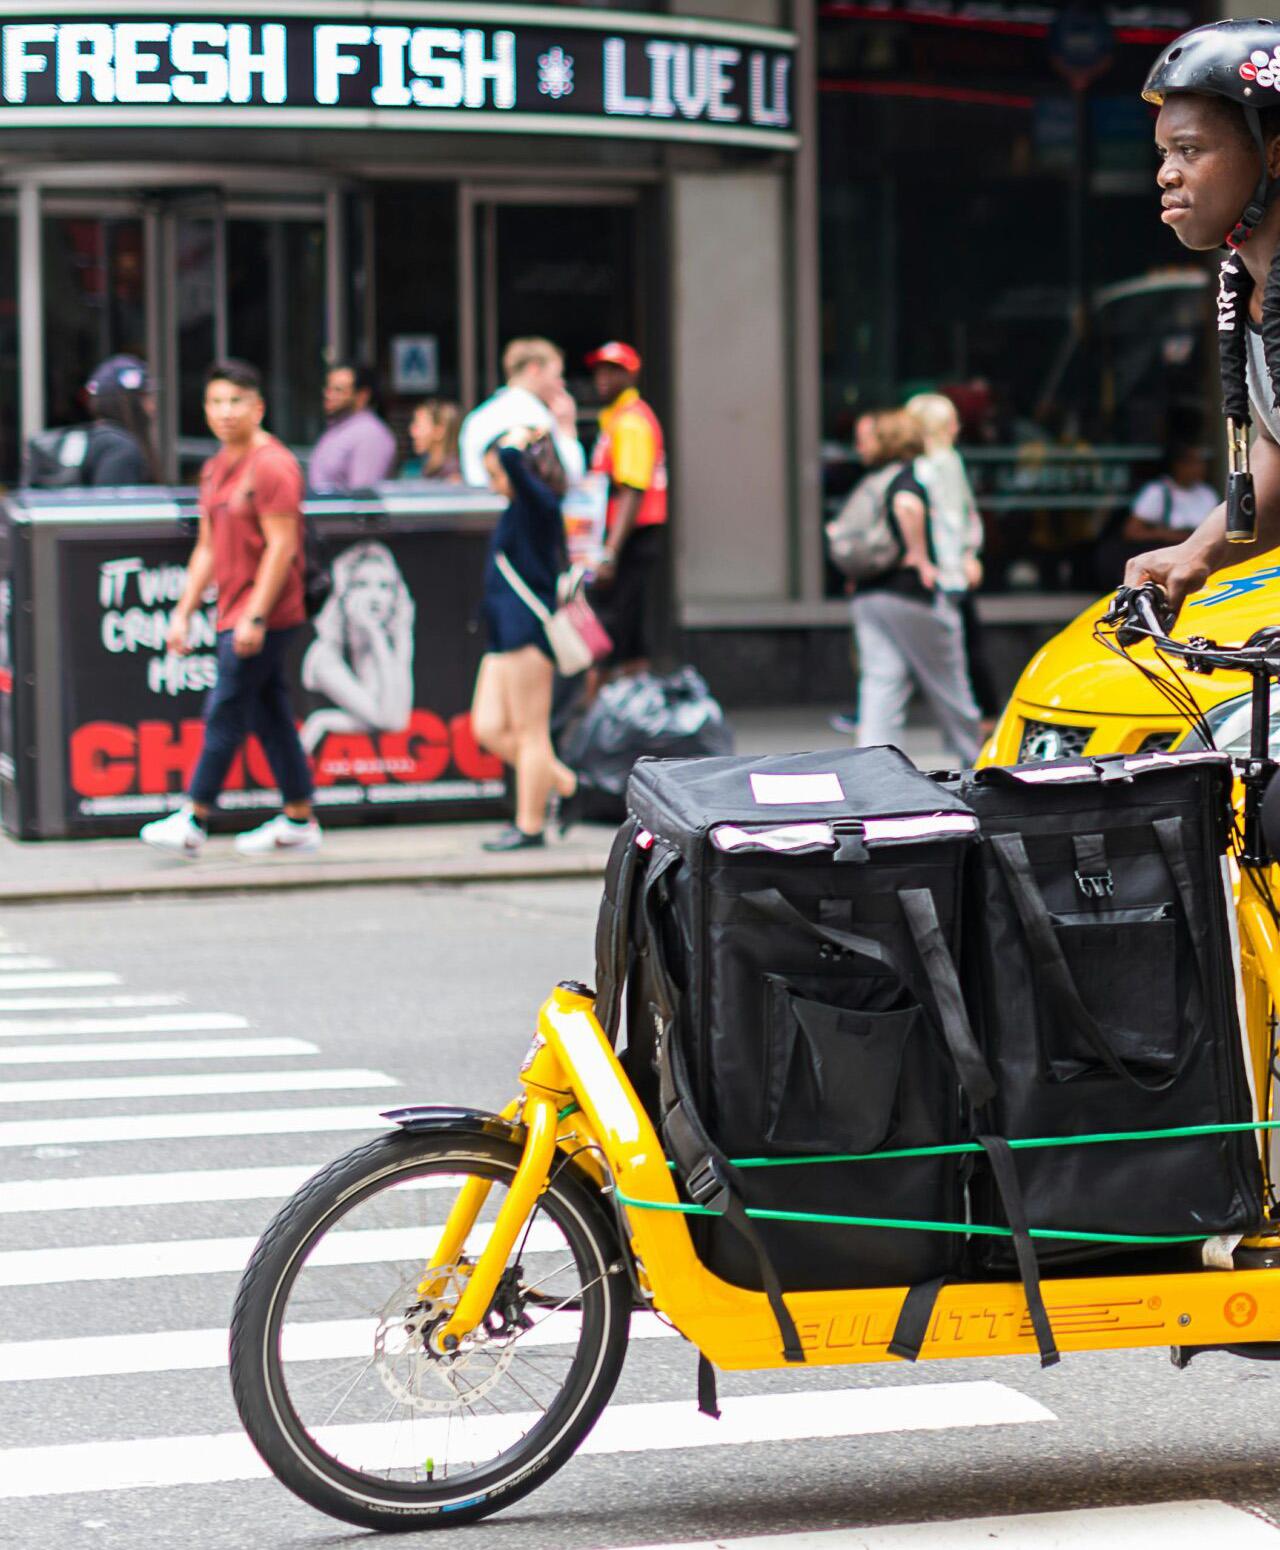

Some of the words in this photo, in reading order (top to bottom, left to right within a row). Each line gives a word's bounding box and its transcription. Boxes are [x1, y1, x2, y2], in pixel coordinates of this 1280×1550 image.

[2, 23, 288, 103] FRESH
[313, 25, 516, 109] FISH
[603, 36, 741, 122] LIVE
[100, 557, 143, 608] IT
[102, 605, 218, 653] CRIMN
[70, 709, 505, 797] CHAG
[801, 1308, 1015, 1352] BULITT
